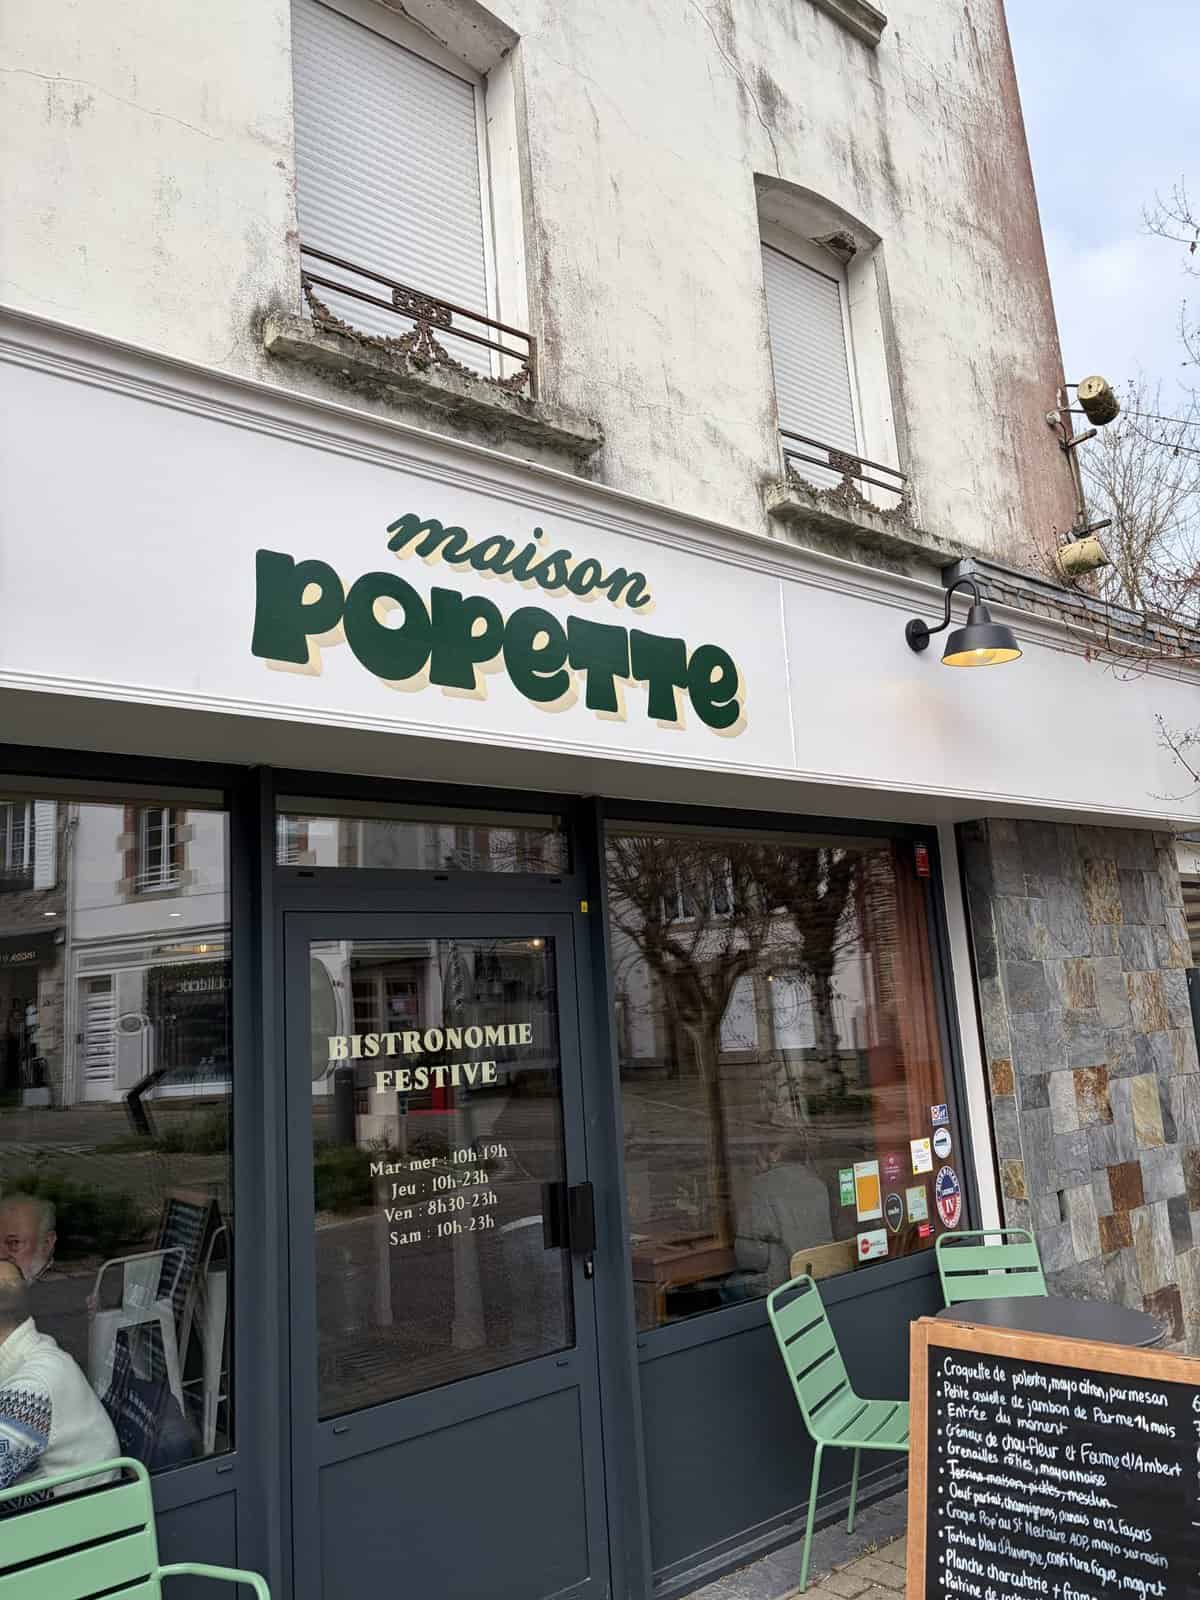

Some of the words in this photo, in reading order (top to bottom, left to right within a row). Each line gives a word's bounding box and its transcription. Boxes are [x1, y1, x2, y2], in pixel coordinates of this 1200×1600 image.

[386, 512, 654, 613] maison
[328, 1023, 533, 1060] BISTRONOMIE
[374, 1061, 497, 1094] FESTIVE
[452, 1144, 508, 1165] 10h-19h
[391, 1183, 416, 1200] Jeu
[431, 1170, 489, 1191] 10h-23h
[384, 1207, 413, 1223] Ven
[427, 1192, 497, 1216] 8h30-23h
[390, 1231, 422, 1247] Sam
[437, 1215, 495, 1237] 10h-23h
[944, 1356, 991, 1383] Croquette
[993, 1366, 1006, 1382] de
[1109, 1387, 1168, 1408] parmesan
[944, 1381, 969, 1400] Petite
[1011, 1395, 1024, 1409] de
[1028, 1398, 1069, 1418] jambon
[1074, 1405, 1087, 1420] de
[1093, 1406, 1134, 1428] Parme
[1151, 1422, 1176, 1438] mois
[947, 1402, 987, 1421] Entrée
[995, 1406, 1011, 1426] du
[1017, 1418, 1068, 1435] moment
[946, 1423, 982, 1444] Crémeux
[985, 1432, 998, 1448] de
[1065, 1444, 1077, 1462] et
[947, 1440, 998, 1463] Grenailles
[1040, 1463, 1107, 1487] mayonnaise
[946, 1501, 976, 1526] Croque
[998, 1518, 1011, 1530] au
[1013, 1518, 1023, 1533] St
[1025, 1520, 1066, 1544] Nectaire
[1091, 1538, 1120, 1557] mayo
[1123, 1547, 1168, 1568] sarrasin
[1093, 1517, 1107, 1531] en
[1107, 1518, 1118, 1534] 2
[1119, 1519, 1152, 1543] façons
[944, 1526, 976, 1547] Tartine
[1123, 1576, 1167, 1600] magret
[946, 1548, 985, 1576] Planche
[987, 1563, 1048, 1594] charcuterie
[945, 1569, 982, 1598] Poitrine
